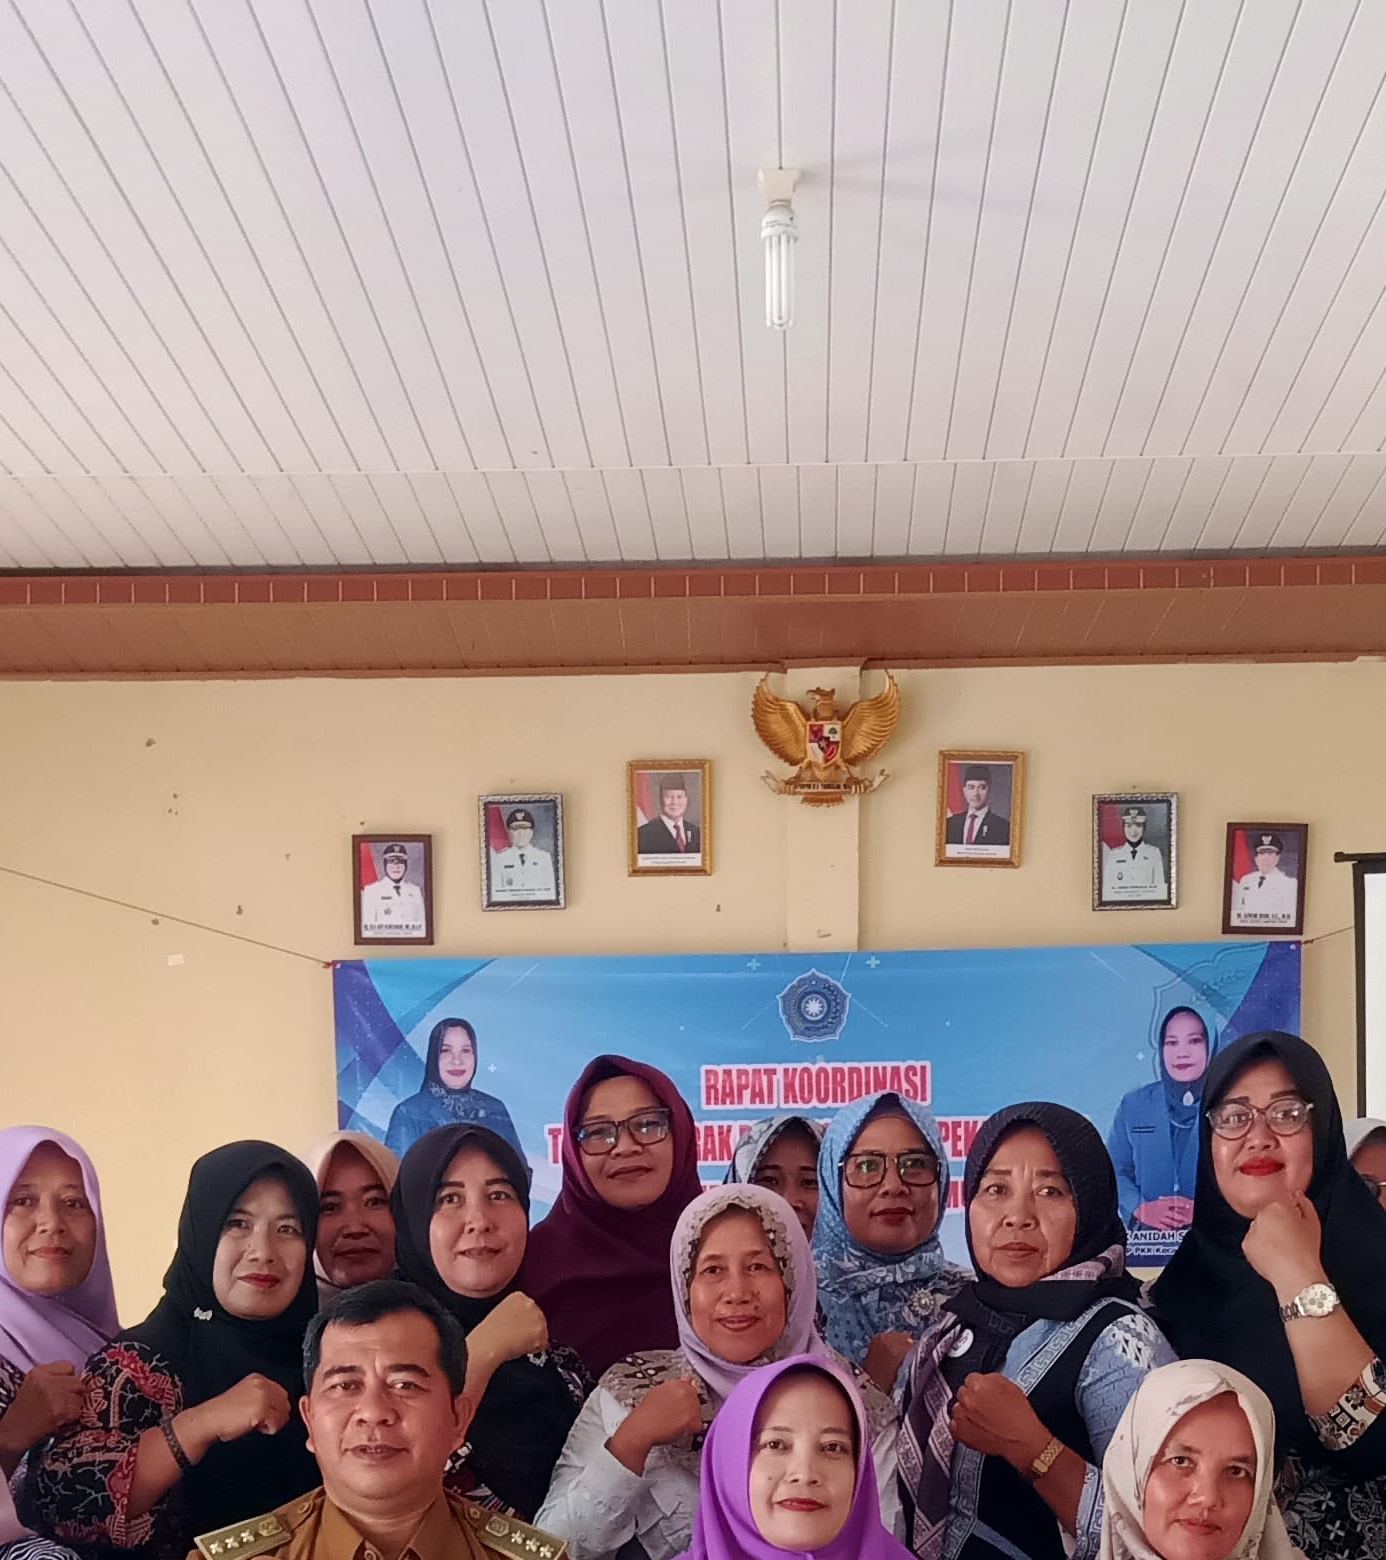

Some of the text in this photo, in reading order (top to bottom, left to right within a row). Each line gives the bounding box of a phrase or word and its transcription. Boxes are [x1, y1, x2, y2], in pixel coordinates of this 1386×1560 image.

[704, 1065, 928, 1106] RAPAT KOORDINASI
[1132, 1231, 1175, 1241] ANIDAH
